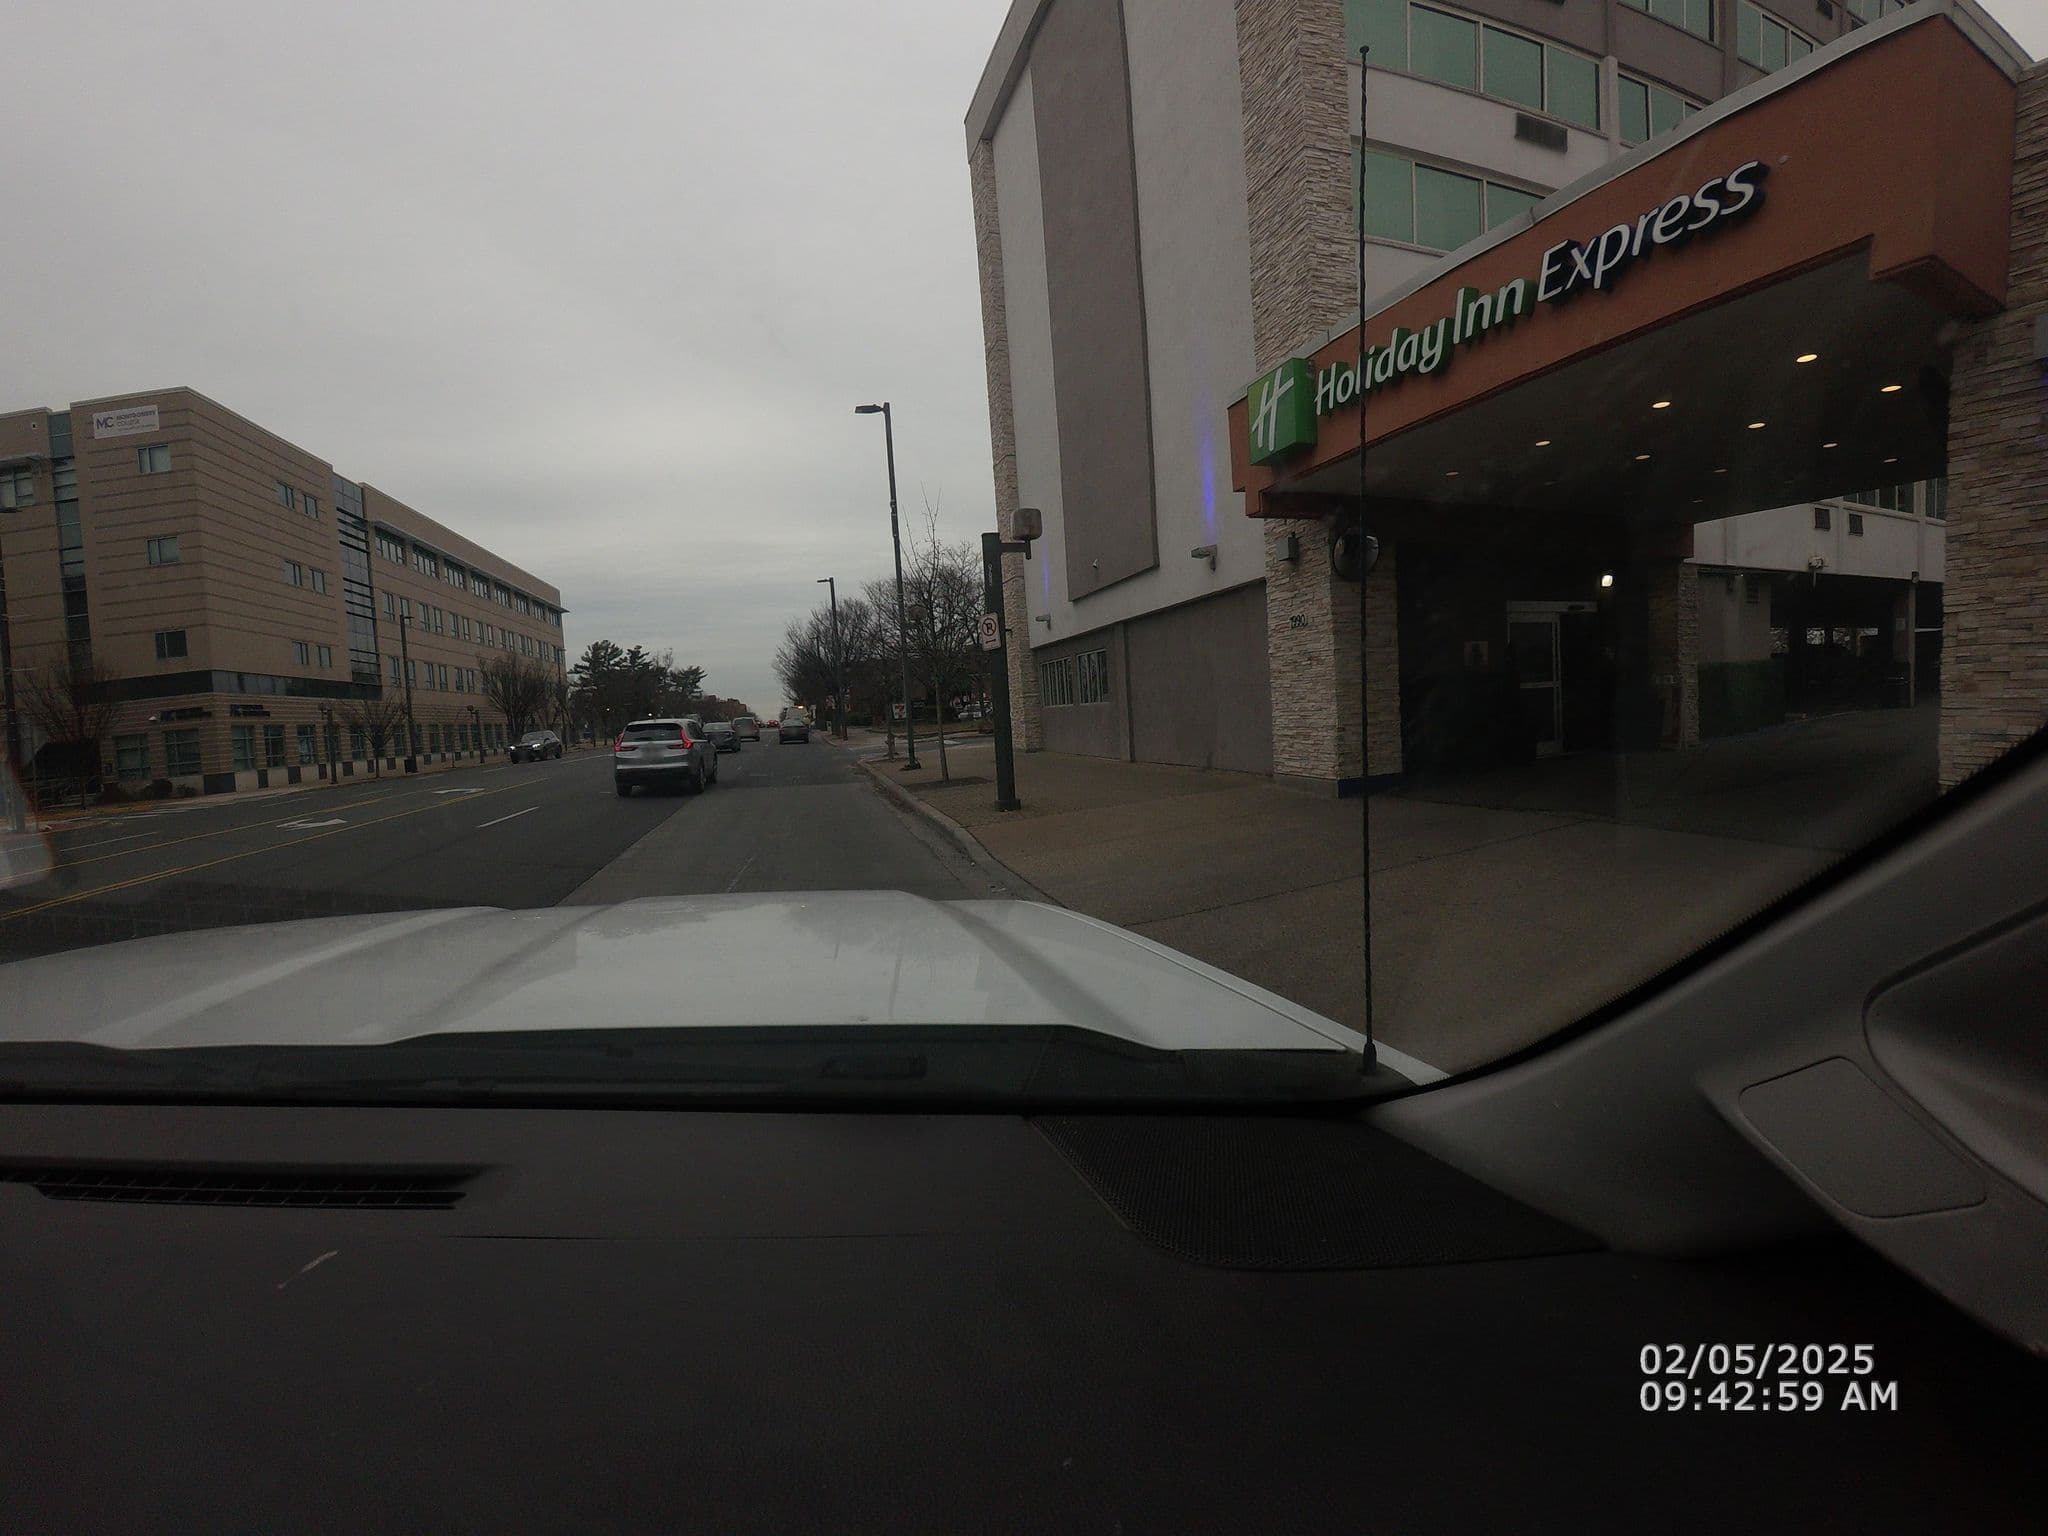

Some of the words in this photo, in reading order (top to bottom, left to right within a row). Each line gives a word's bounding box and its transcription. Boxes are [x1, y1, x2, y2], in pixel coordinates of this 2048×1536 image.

[1314, 317, 1450, 416] Holiday
[1453, 277, 1530, 345] Inn
[1536, 160, 1762, 304] Express
[96, 417, 114, 429] MC
